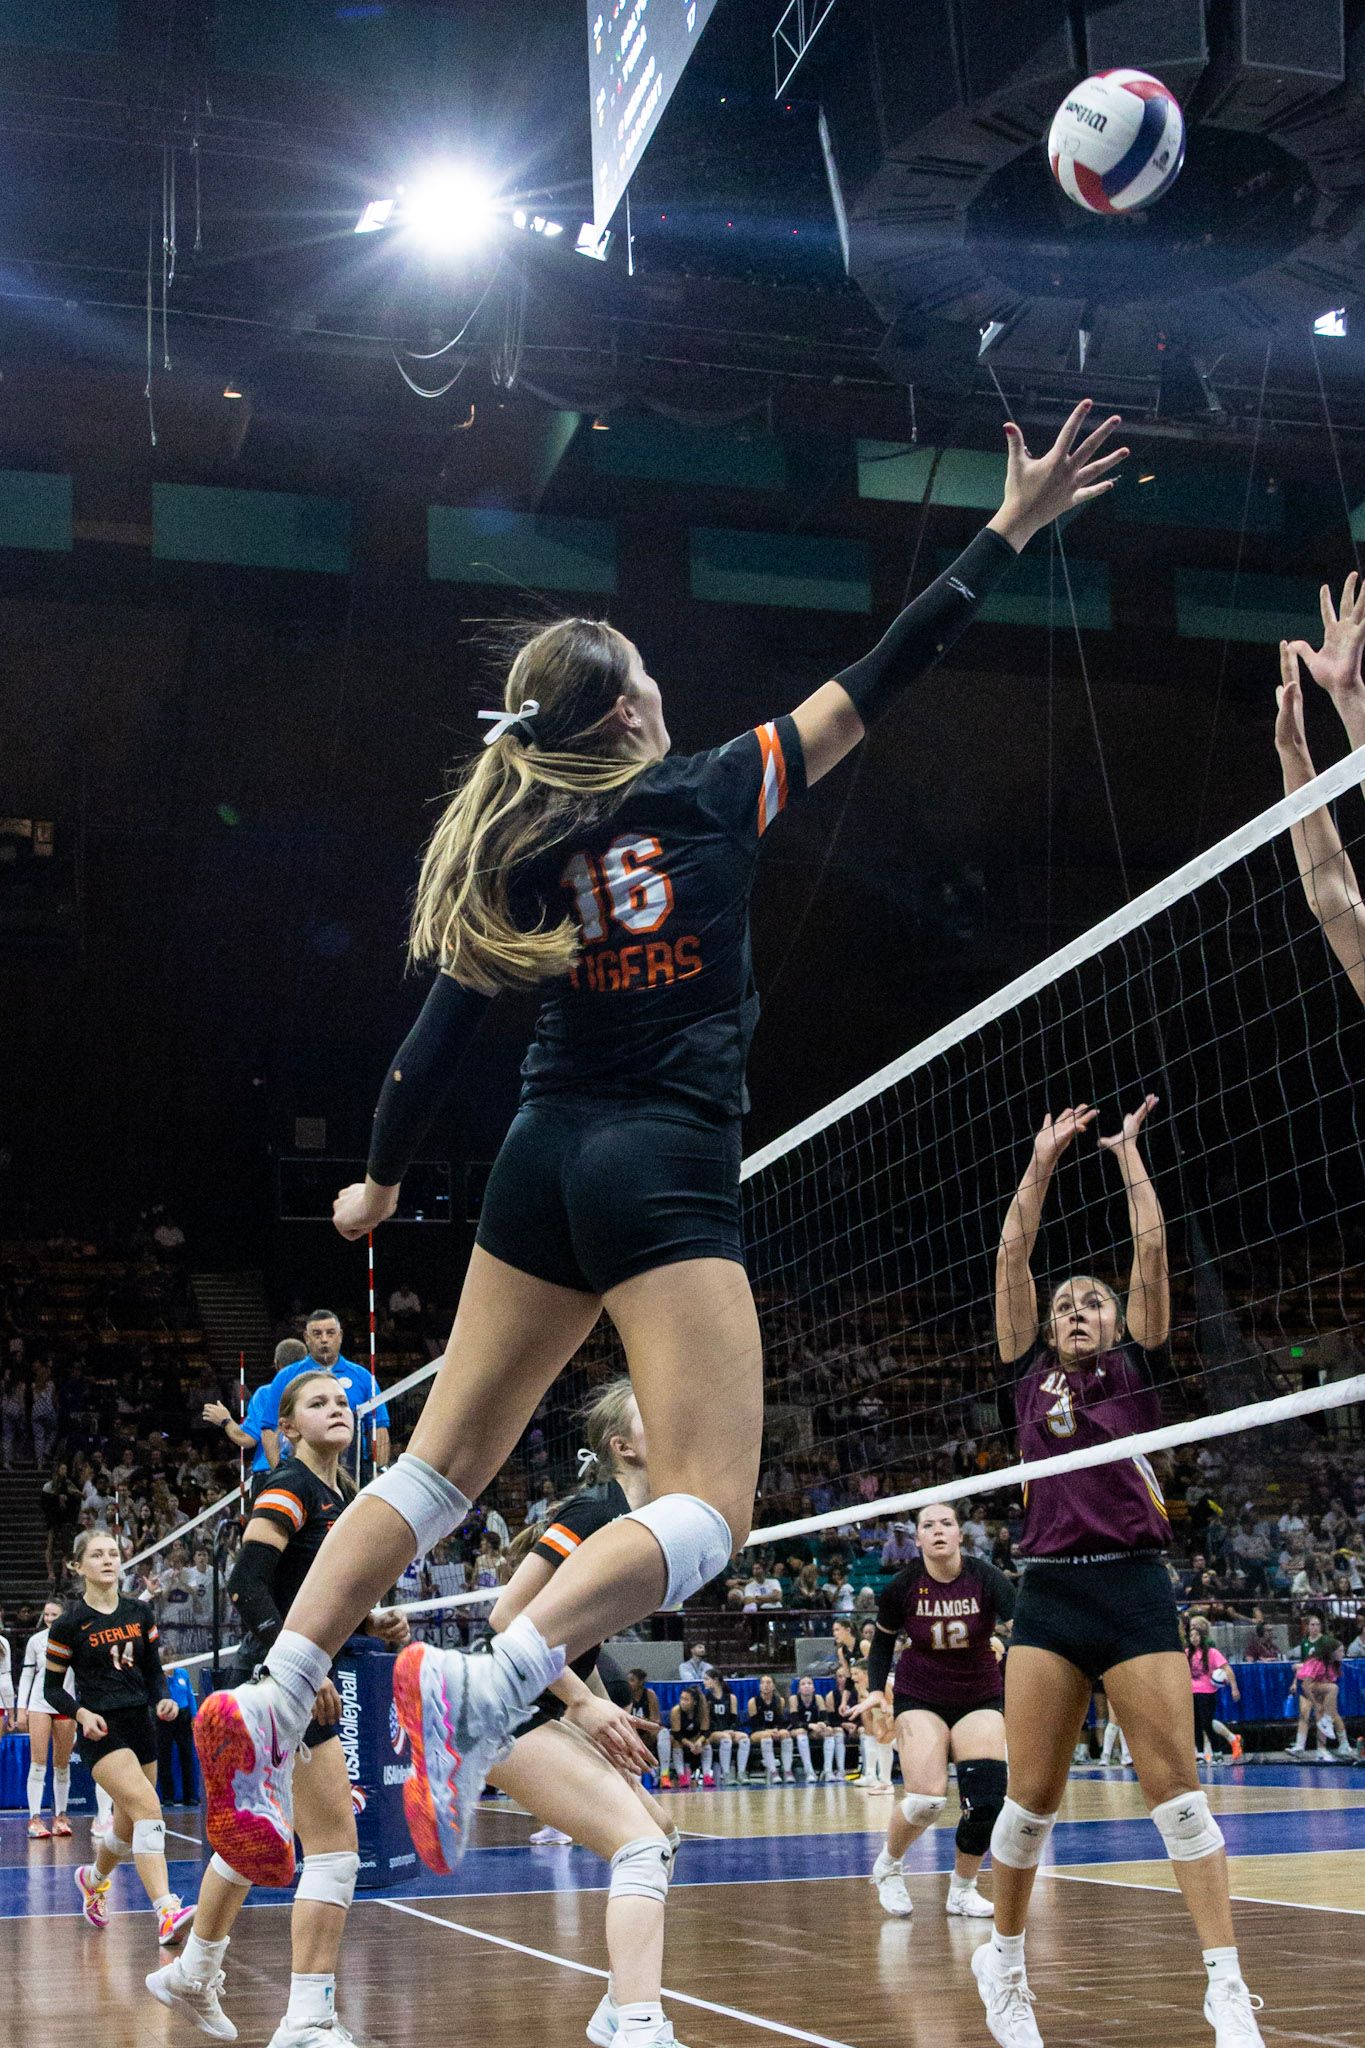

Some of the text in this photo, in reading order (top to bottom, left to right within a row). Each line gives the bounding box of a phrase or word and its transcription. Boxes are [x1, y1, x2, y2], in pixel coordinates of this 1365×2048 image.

[560, 833, 674, 943] 16
[915, 1597, 981, 1617] ALAMOSA
[930, 1620, 970, 1650] 12
[109, 1641, 134, 1671] 14
[713, 1703, 726, 1715] 10
